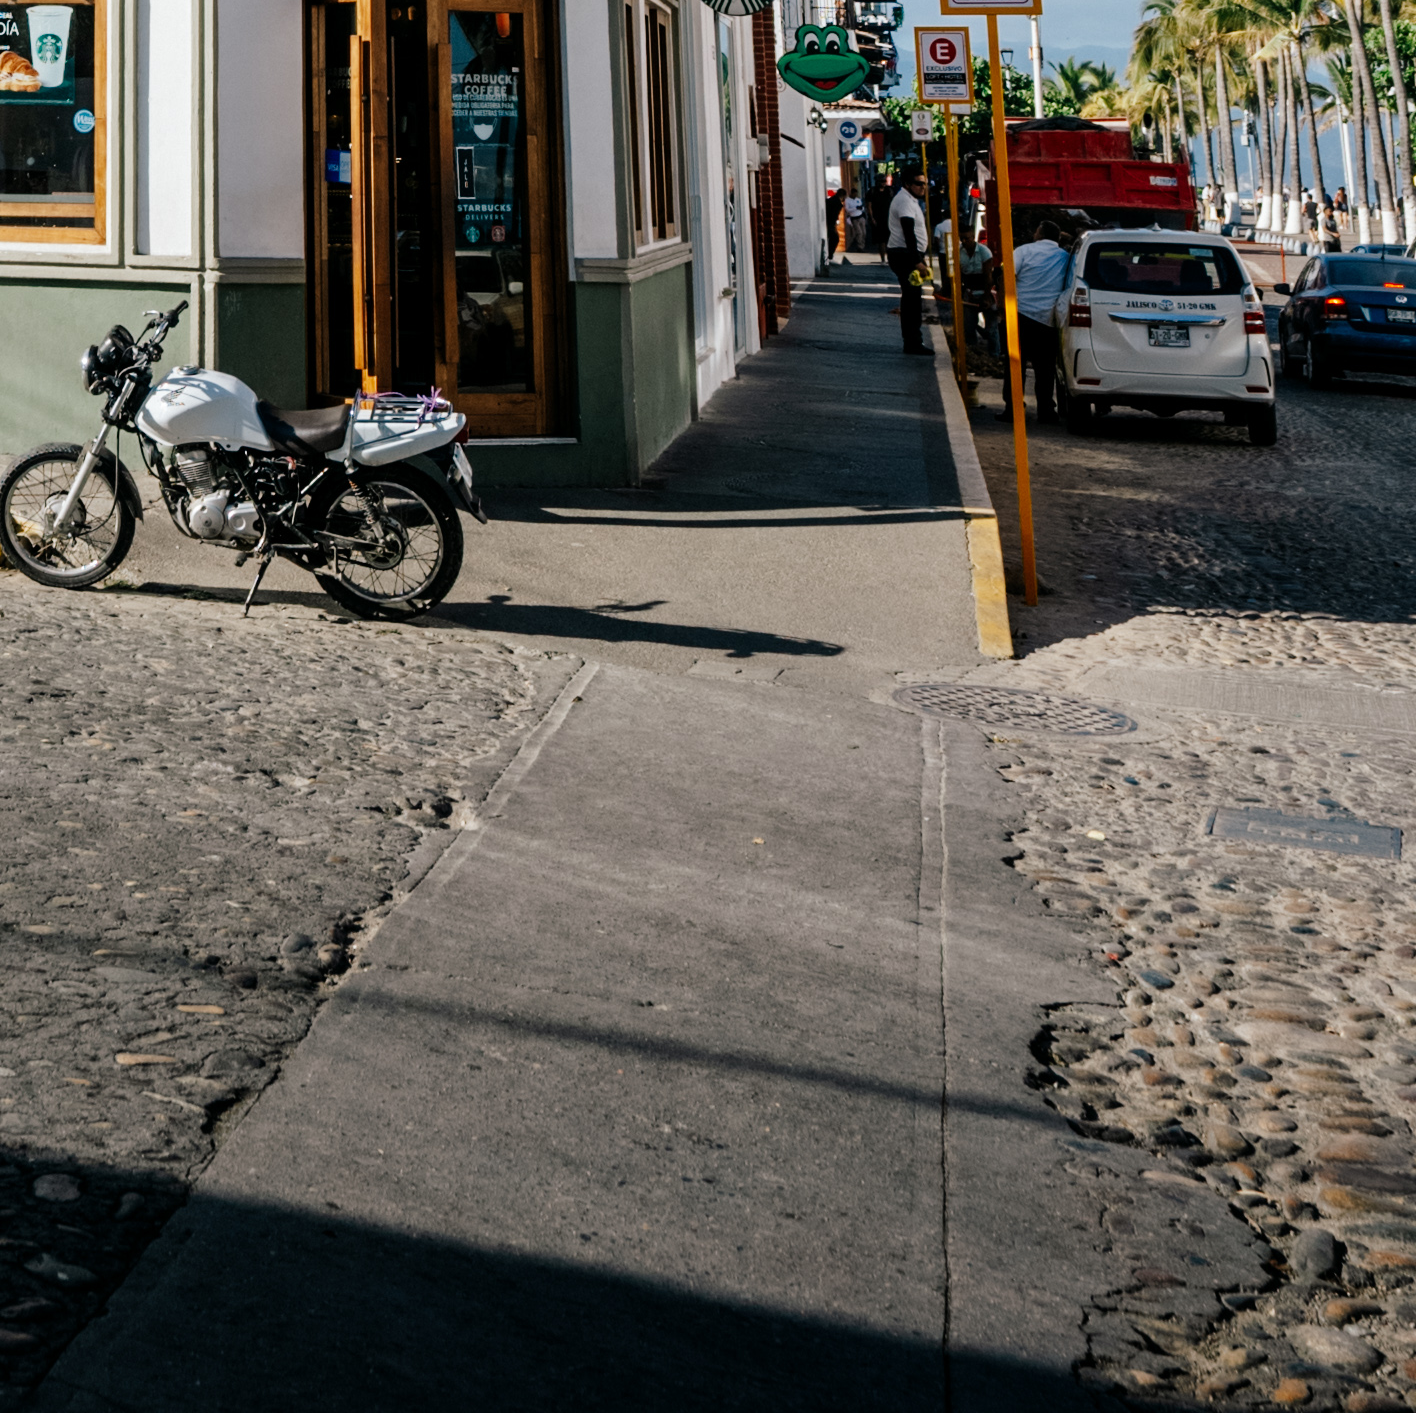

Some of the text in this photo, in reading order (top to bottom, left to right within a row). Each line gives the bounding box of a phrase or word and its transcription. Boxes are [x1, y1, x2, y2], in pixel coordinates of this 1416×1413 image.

[935, 43, 950, 60] E
[464, 85, 507, 95] COFFEE
[457, 204, 512, 212] STARBUCKS
[1126, 300, 1157, 308] JALISCO
[1199, 301, 1217, 311] GMK
